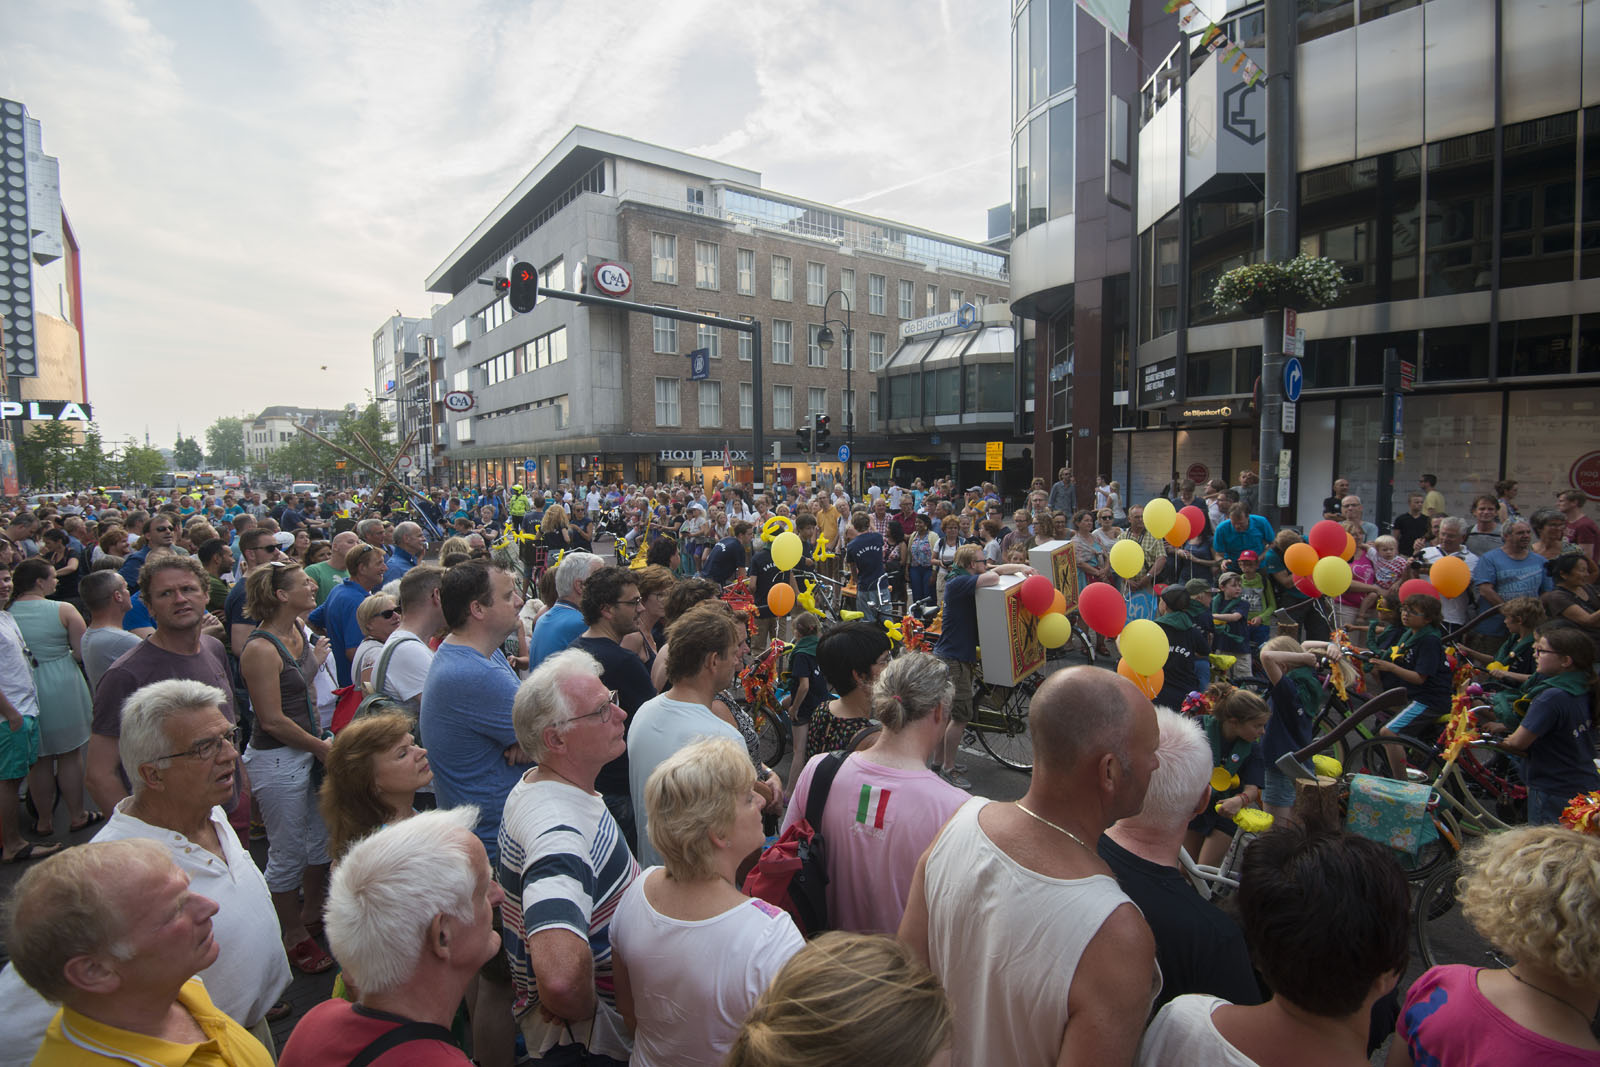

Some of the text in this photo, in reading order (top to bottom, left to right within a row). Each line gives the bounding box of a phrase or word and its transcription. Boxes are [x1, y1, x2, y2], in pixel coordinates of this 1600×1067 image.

[601, 270, 626, 288] C&A
[904, 314, 957, 334] de Bijenkorf
[450, 395, 469, 406] C&A
[0, 402, 89, 420] PLA
